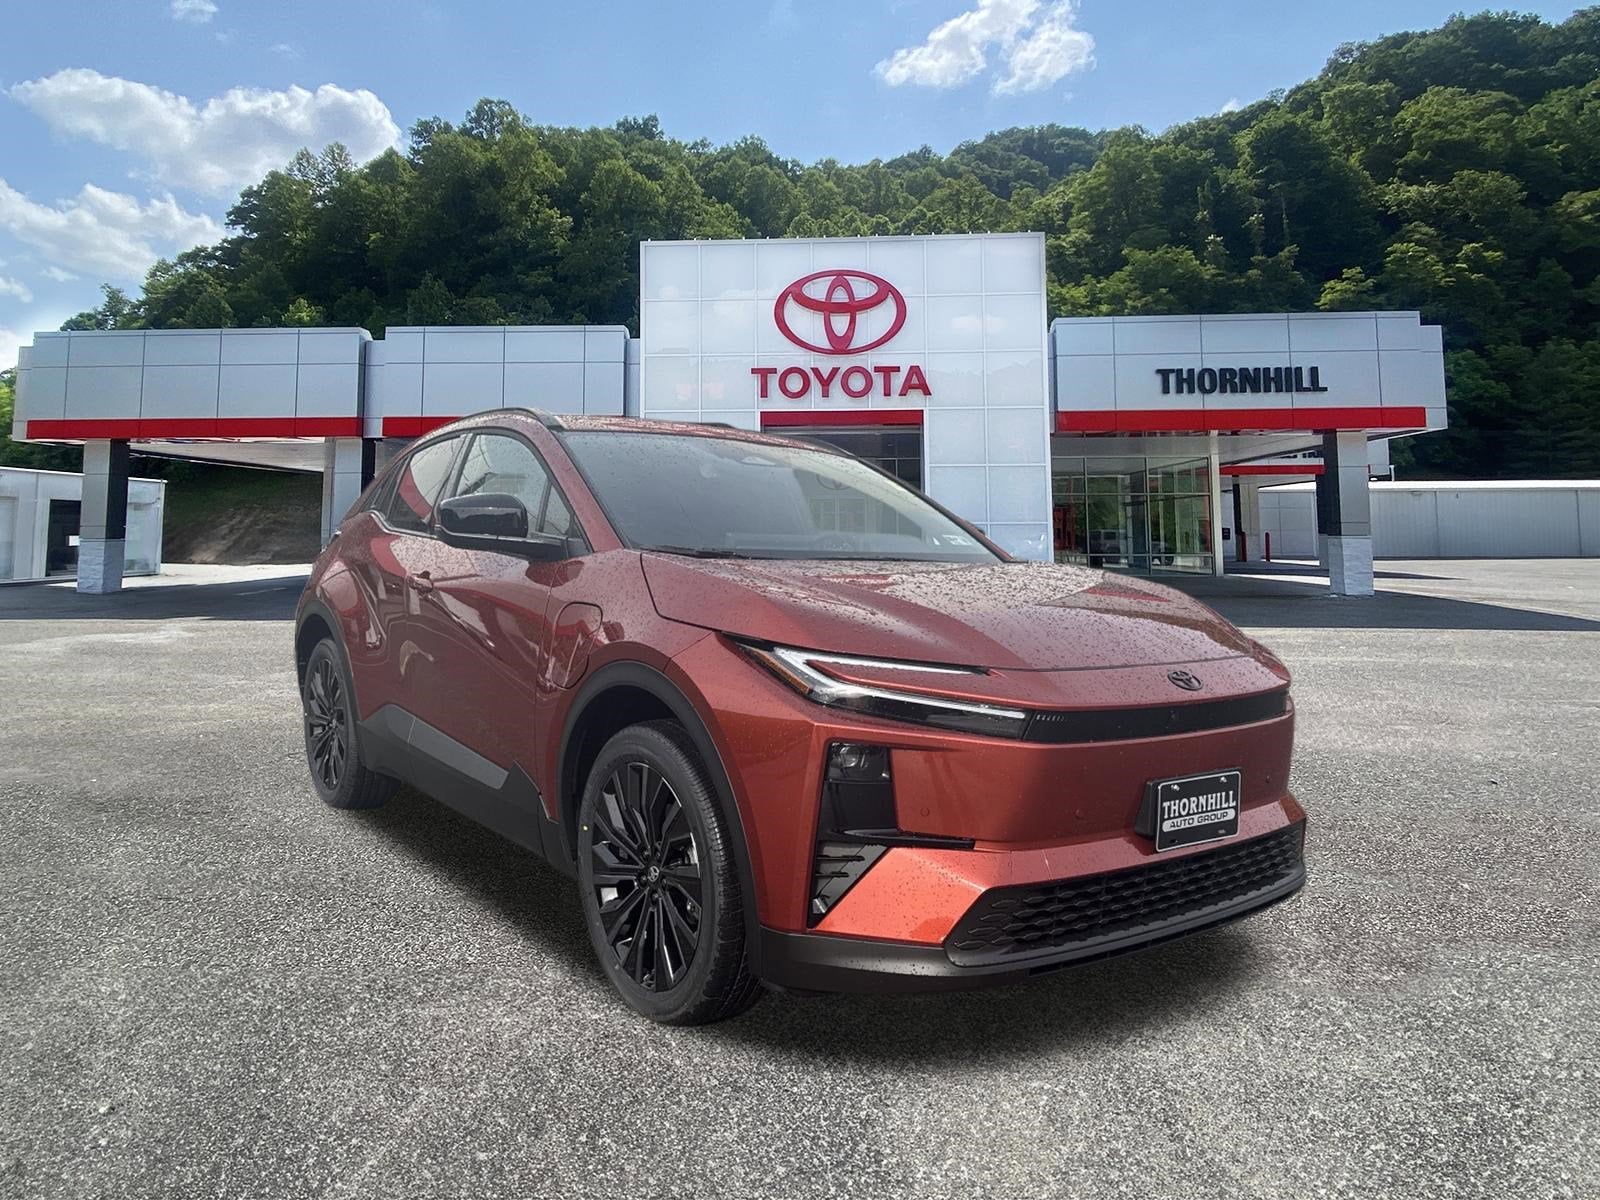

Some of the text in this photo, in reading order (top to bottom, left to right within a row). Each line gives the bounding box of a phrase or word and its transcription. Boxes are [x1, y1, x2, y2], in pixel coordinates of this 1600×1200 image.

[751, 365, 932, 399] TOYOTA
[1155, 366, 1328, 395] THORNHILL
[1162, 790, 1237, 819] THORNHILL
[1169, 811, 1228, 829] AUTO GROUP
